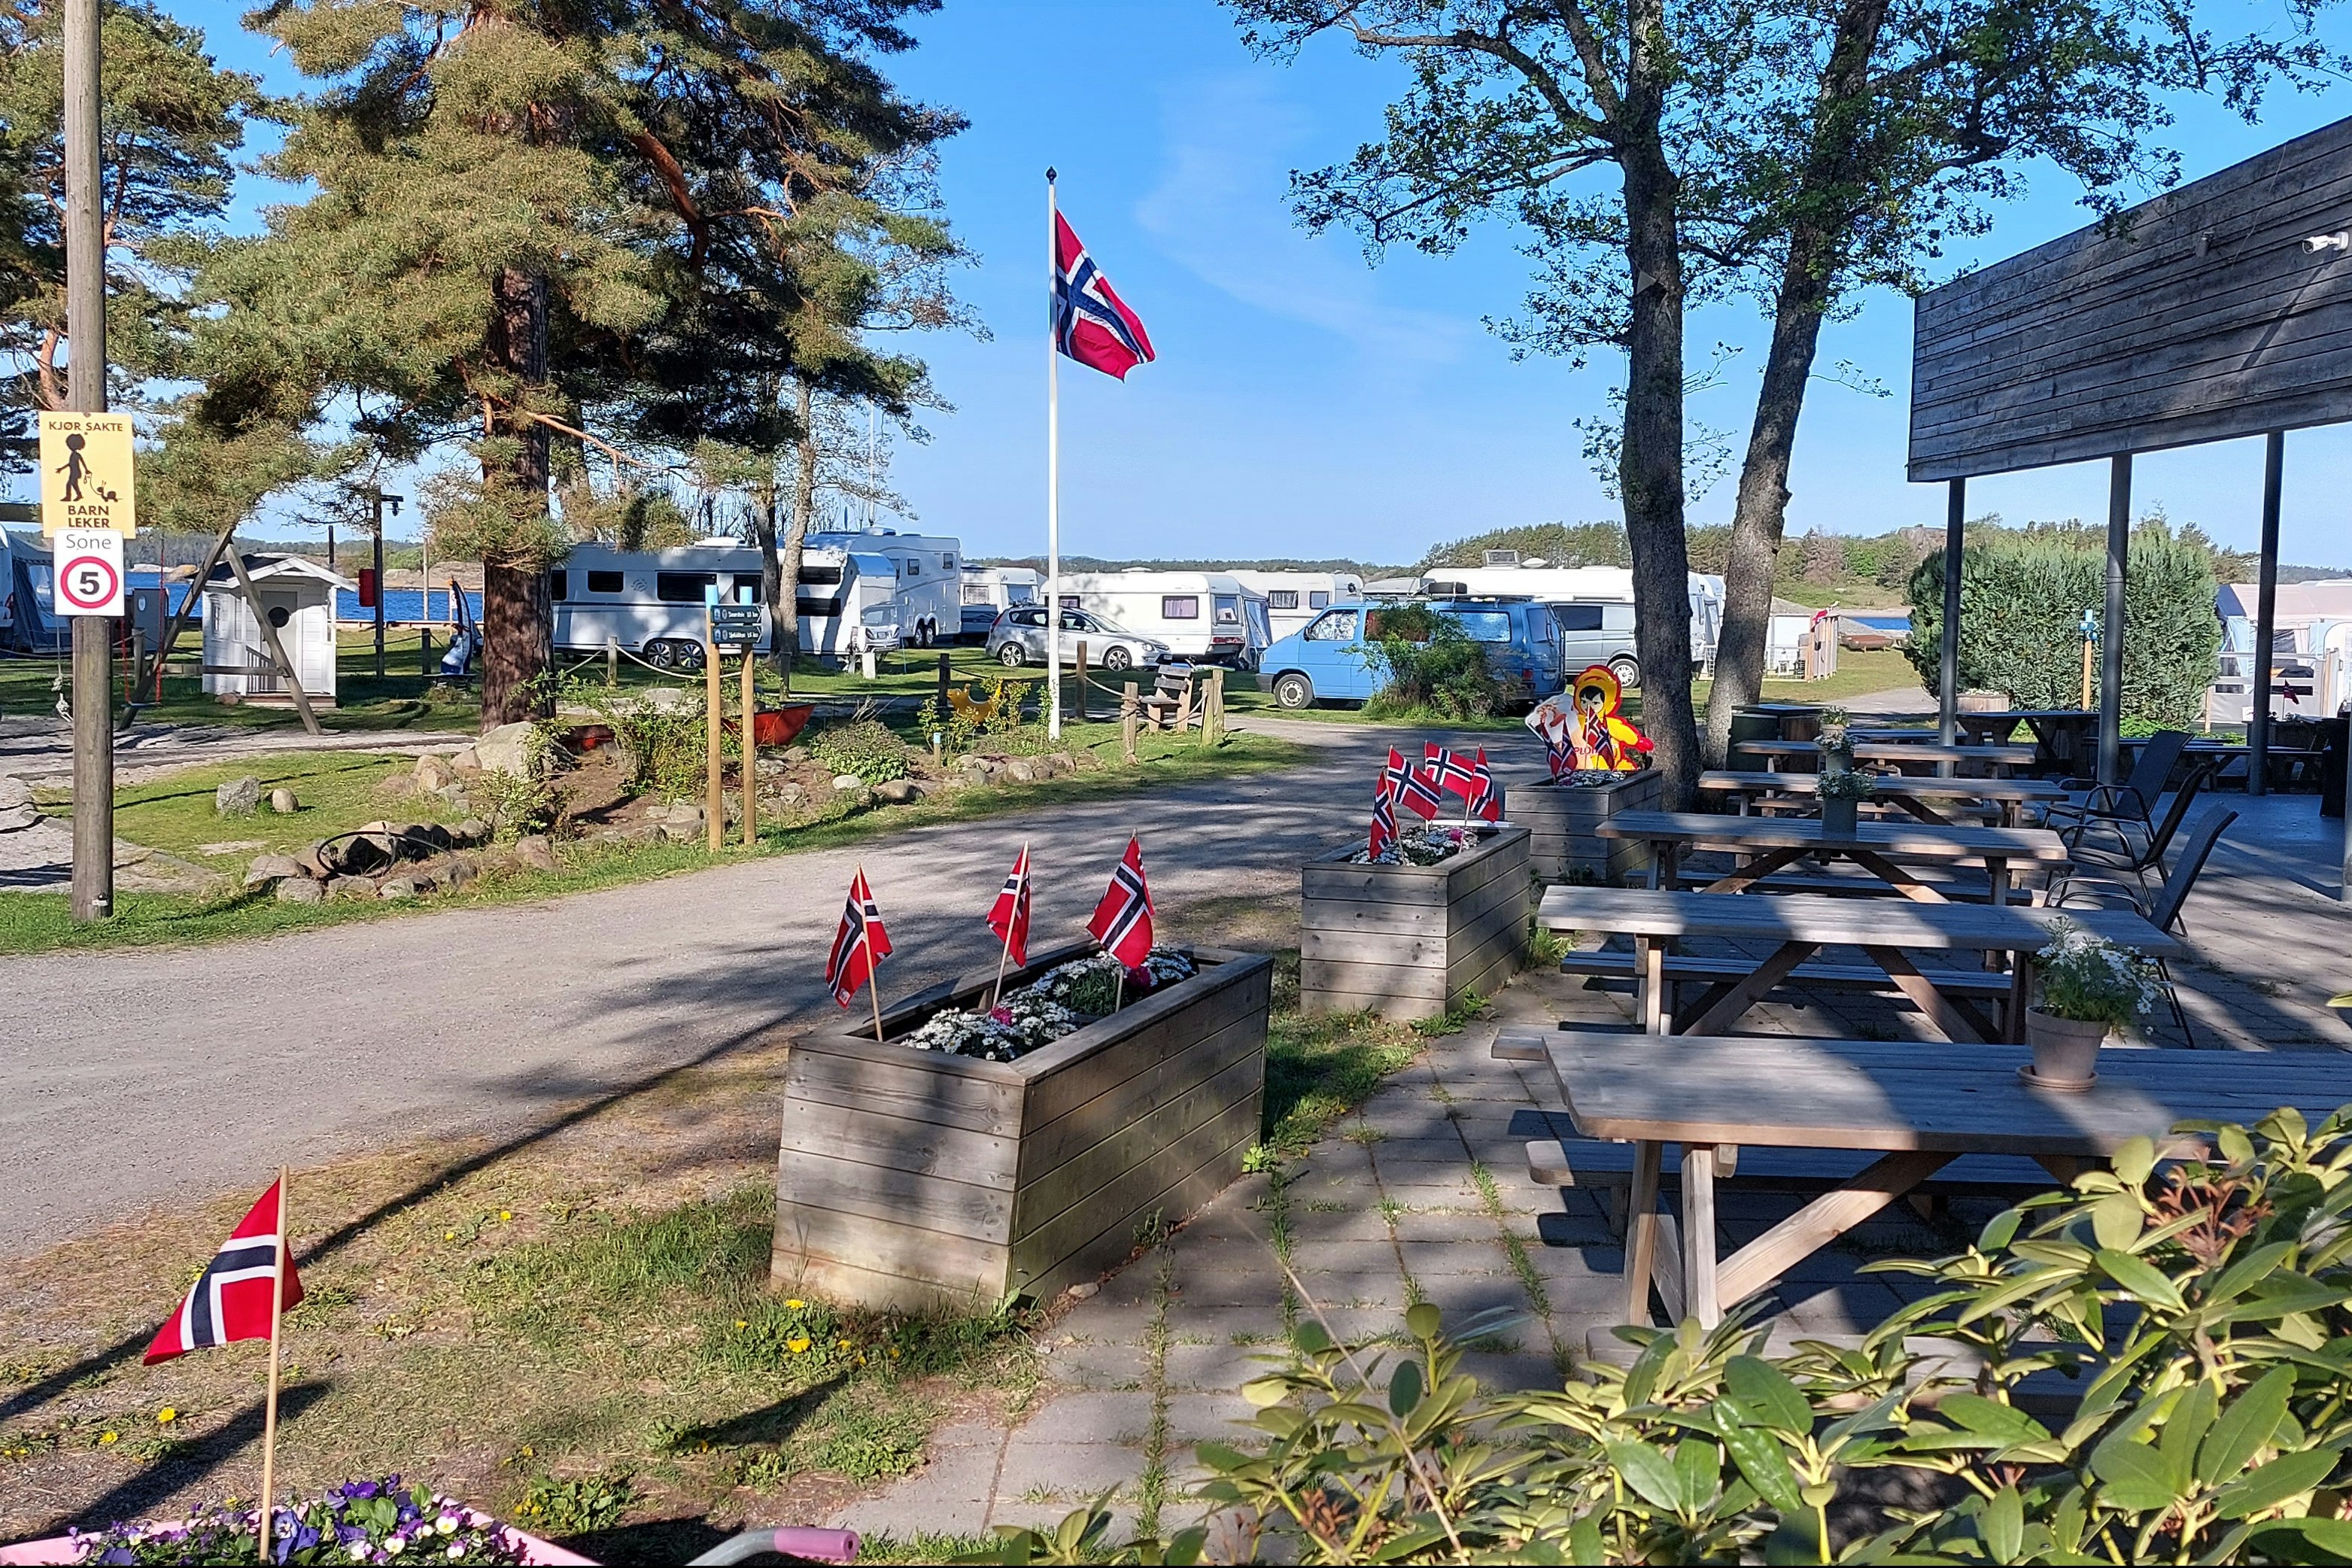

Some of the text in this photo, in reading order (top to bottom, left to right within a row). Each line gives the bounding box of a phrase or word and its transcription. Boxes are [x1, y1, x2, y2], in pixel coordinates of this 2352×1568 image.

[49, 421, 123, 432] KJØR SAKTE
[68, 505, 109, 515] BARN
[68, 517, 110, 528] LEKER
[66, 533, 111, 549] Sone
[79, 571, 100, 595] 5
